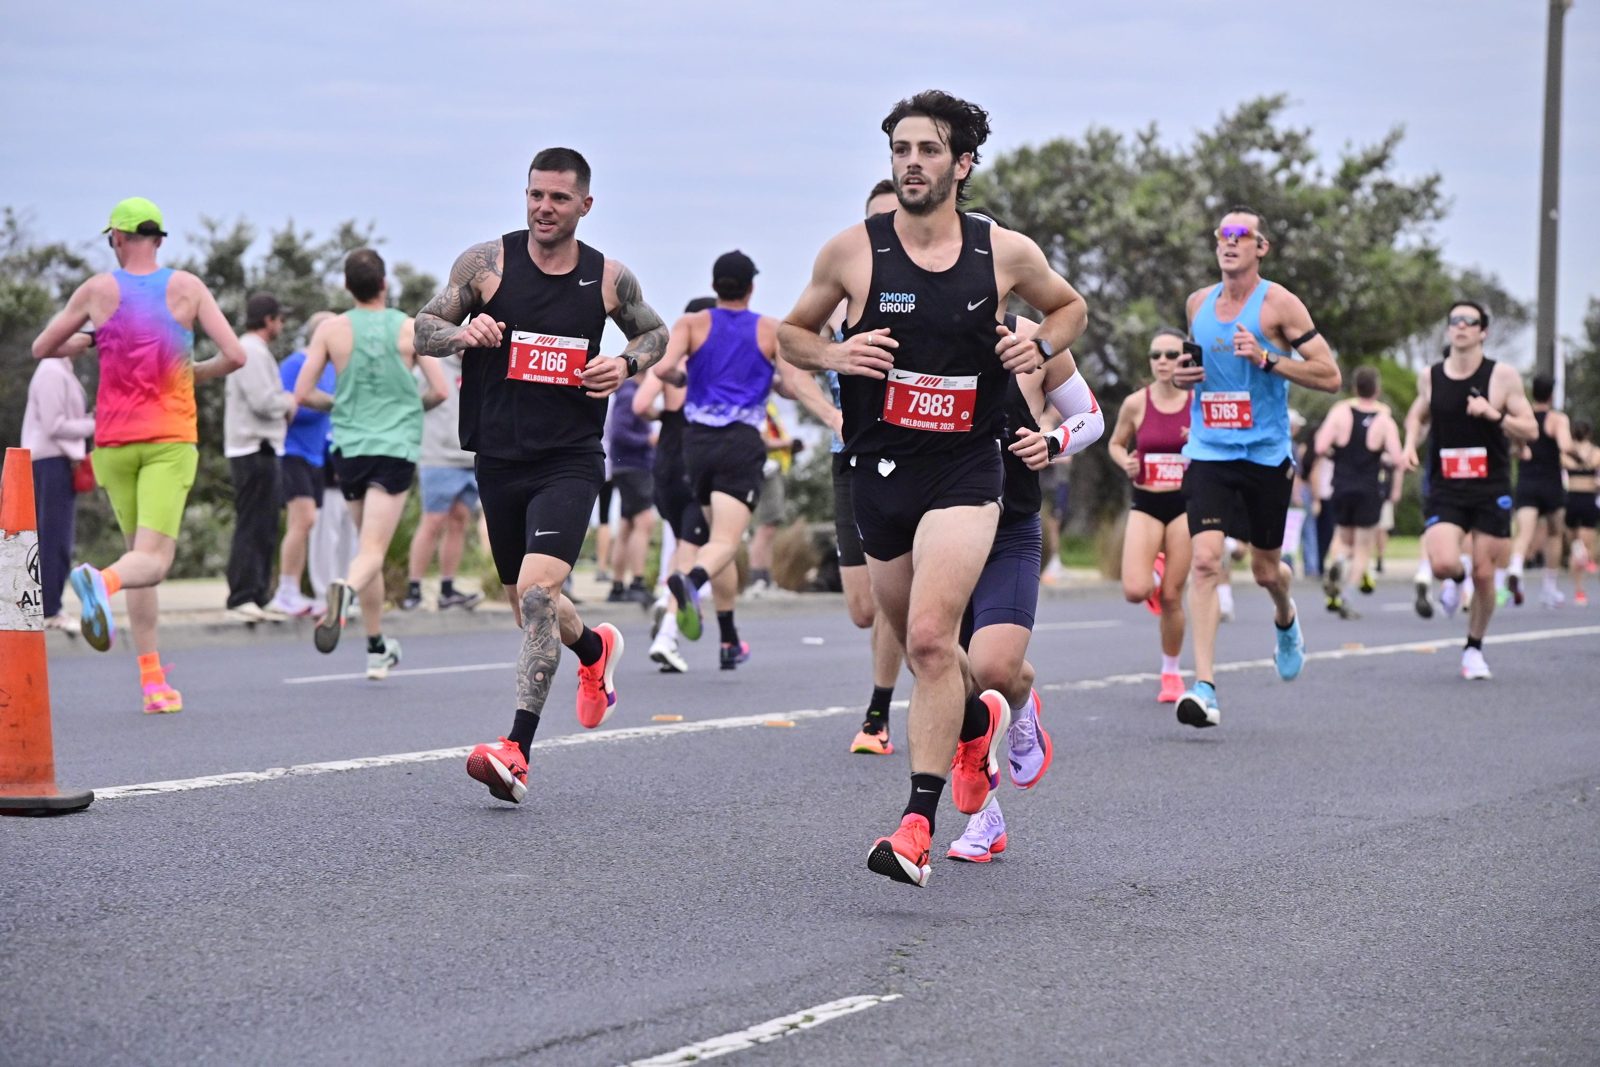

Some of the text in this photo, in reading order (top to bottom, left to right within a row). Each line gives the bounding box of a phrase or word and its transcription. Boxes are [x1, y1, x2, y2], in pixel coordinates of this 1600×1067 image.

[880, 292, 916, 303] 2MORO
[880, 302, 916, 313] GROUP
[528, 349, 568, 373] 2166
[522, 373, 555, 384] MELBOURNE
[907, 390, 955, 417] 7983
[1210, 402, 1239, 421] 5763
[900, 417, 939, 430] MELBOURNE
[20, 589, 43, 609] AL
